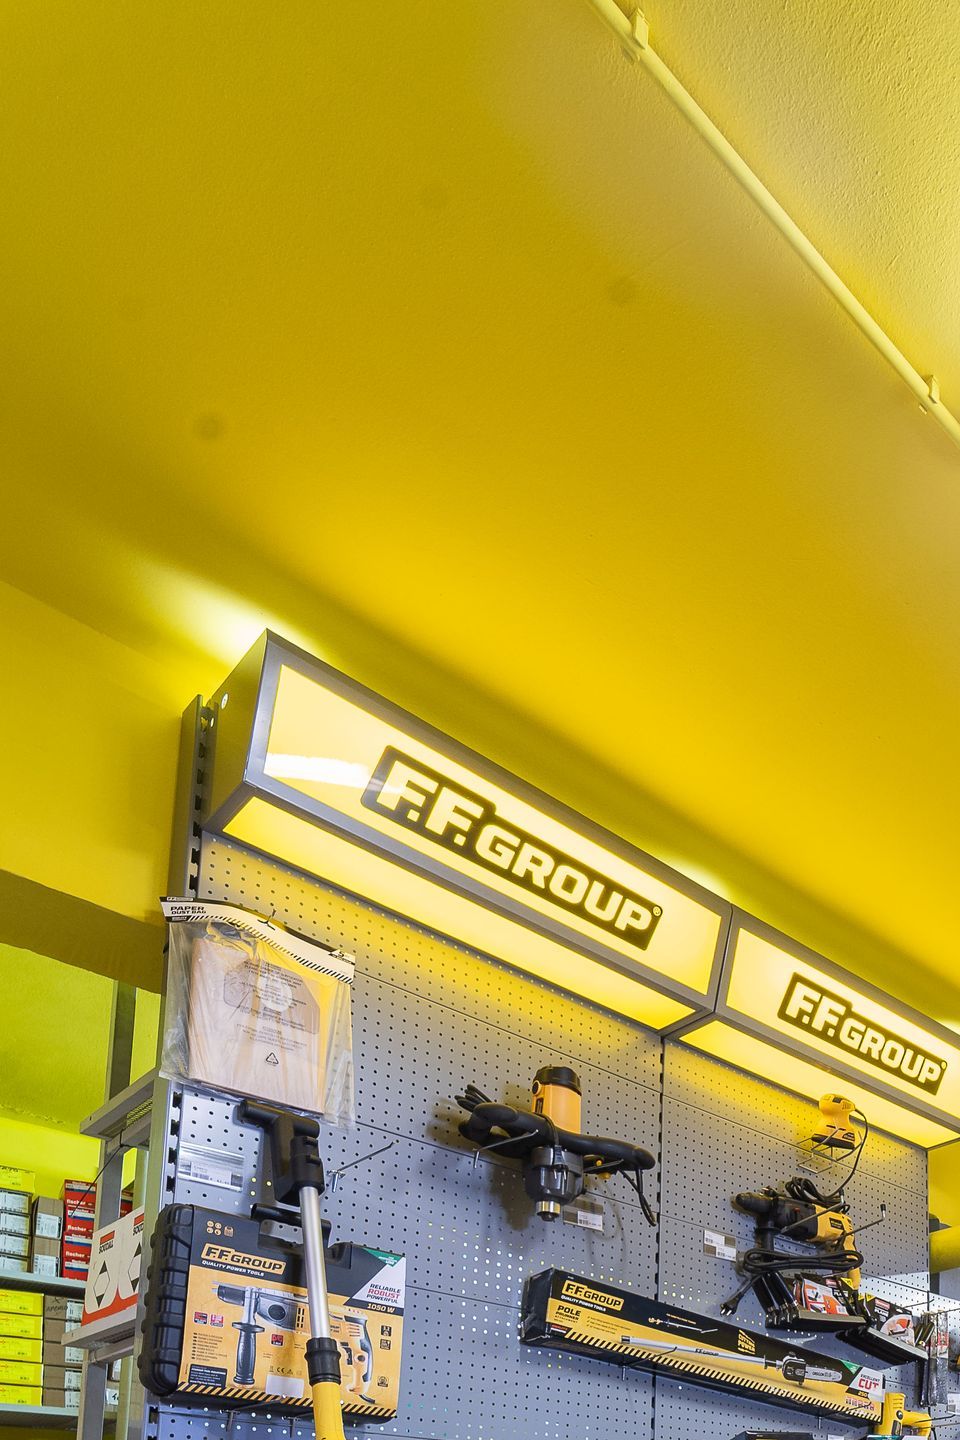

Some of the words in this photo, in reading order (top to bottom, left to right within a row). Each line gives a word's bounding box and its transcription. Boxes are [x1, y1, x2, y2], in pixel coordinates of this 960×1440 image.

[202, 1260, 226, 1269] QUALITY
[226, 1265, 248, 1274] POWER
[247, 1269, 264, 1277] TOOLS
[369, 1283, 401, 1293] RELIABLE
[367, 1288, 400, 1299] ROBUST
[366, 1294, 398, 1304] POWERFUL
[561, 1294, 579, 1304] QUALITY
[367, 1303, 386, 1311] 1050
[557, 1304, 582, 1317] POLE
[858, 1378, 879, 1390] CUT
